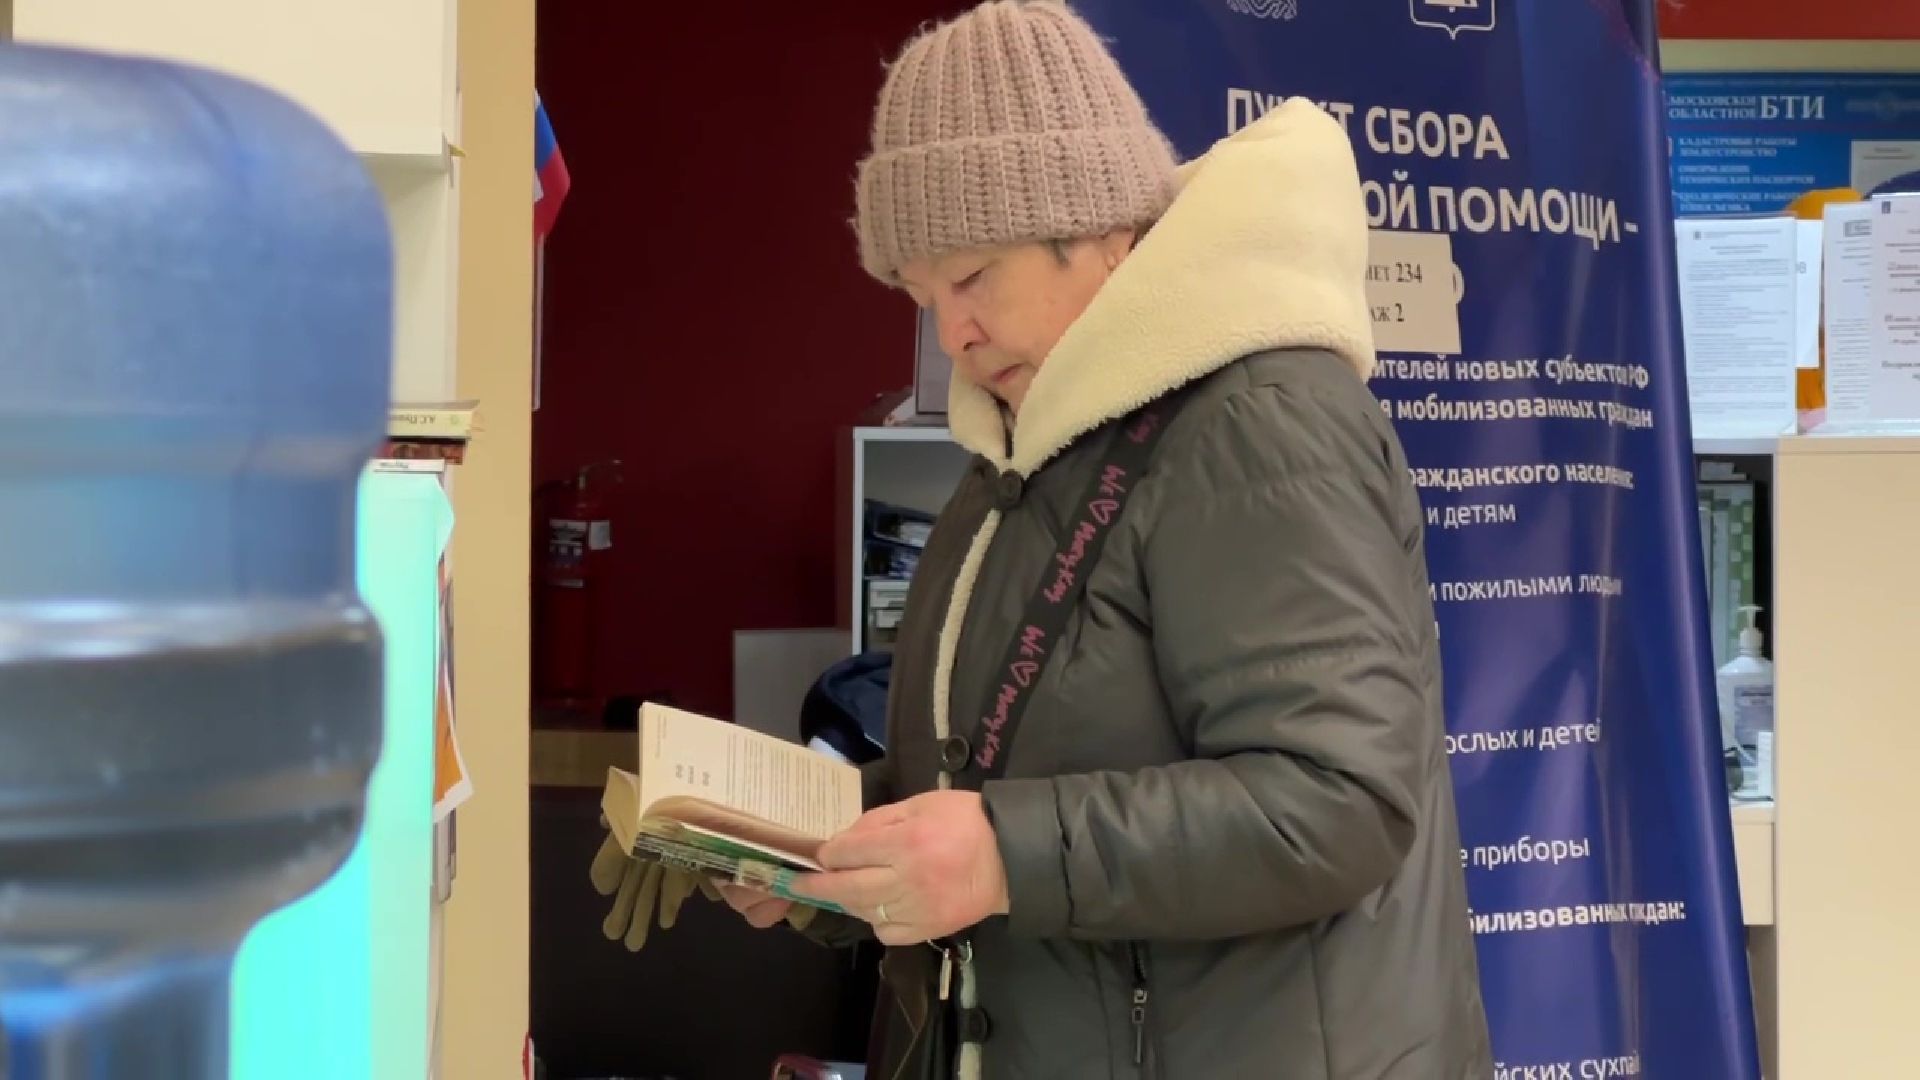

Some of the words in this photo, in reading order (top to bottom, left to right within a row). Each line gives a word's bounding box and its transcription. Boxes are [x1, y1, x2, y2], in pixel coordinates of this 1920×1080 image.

[1760, 95, 1825, 120] БТИ
[1365, 105, 1510, 161] СБОРА
[1428, 186, 1621, 250] ПОМОЩИ
[1395, 262, 1423, 283] 234
[1395, 303, 1405, 322] 2
[1455, 358, 1540, 379] новых
[1397, 393, 1596, 421] мобилизованных
[1427, 507, 1439, 525] и
[1443, 504, 1517, 529] детям
[1441, 574, 1573, 601] пожилыми
[1523, 729, 1534, 748] и
[1473, 835, 1591, 871] приборы
[1468, 902, 1627, 934] илизованнх
